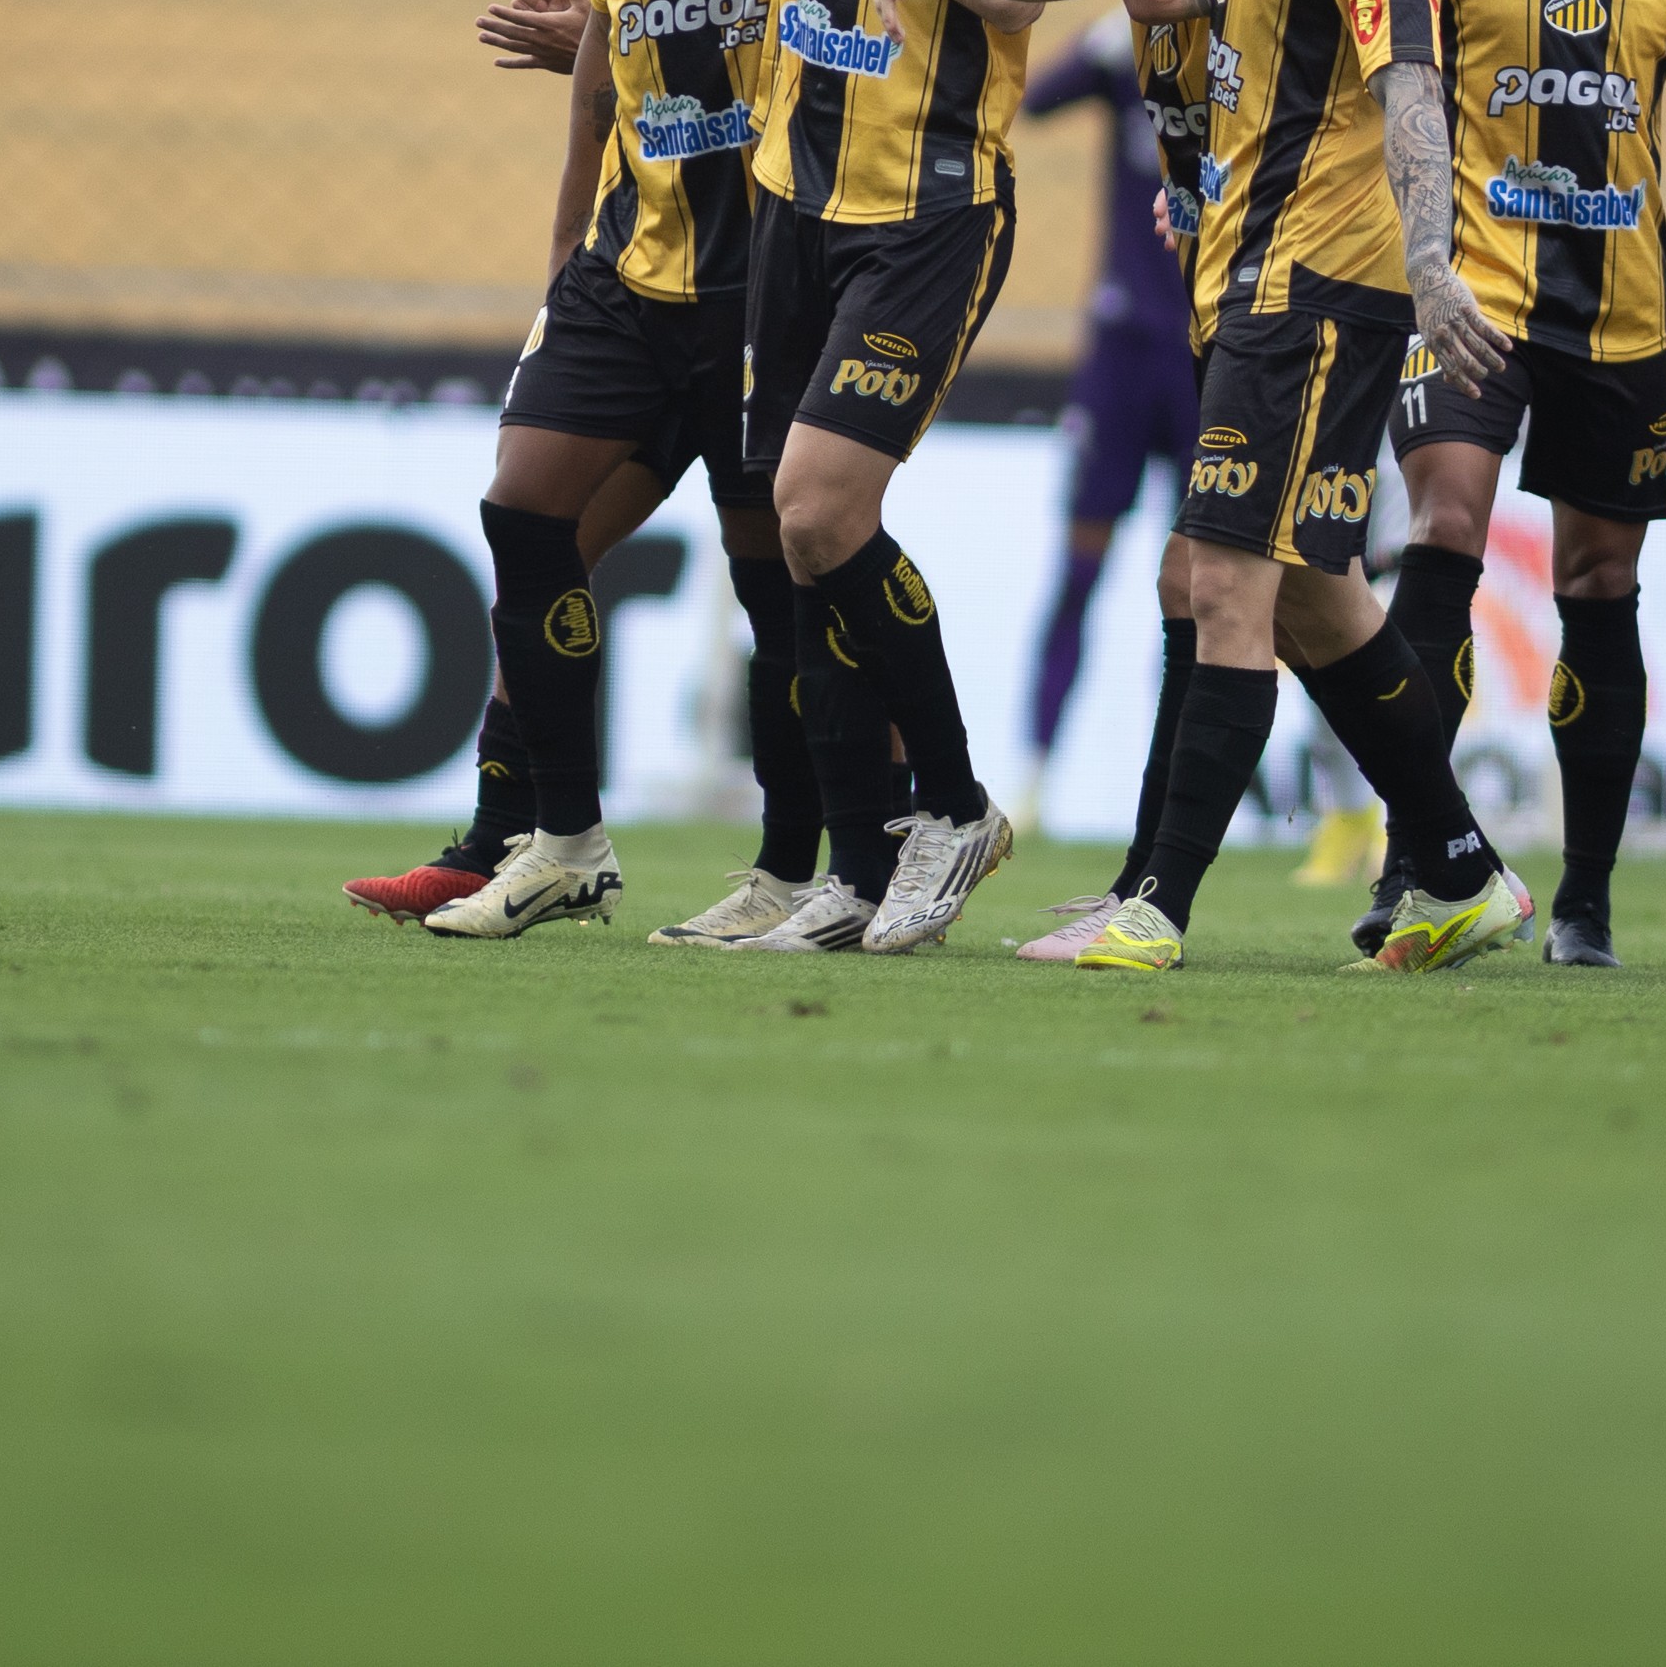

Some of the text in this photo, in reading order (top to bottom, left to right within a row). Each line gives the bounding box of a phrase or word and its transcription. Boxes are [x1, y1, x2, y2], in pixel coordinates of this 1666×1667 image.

[1209, 80, 1238, 113] .bet
[1505, 158, 1573, 185] Açúcar
[1488, 179, 1640, 226] Santaisabel
[868, 334, 914, 356] PHYSICUS
[829, 360, 921, 406] Poty
[1401, 382, 1427, 429] 11
[883, 902, 953, 939] F50
